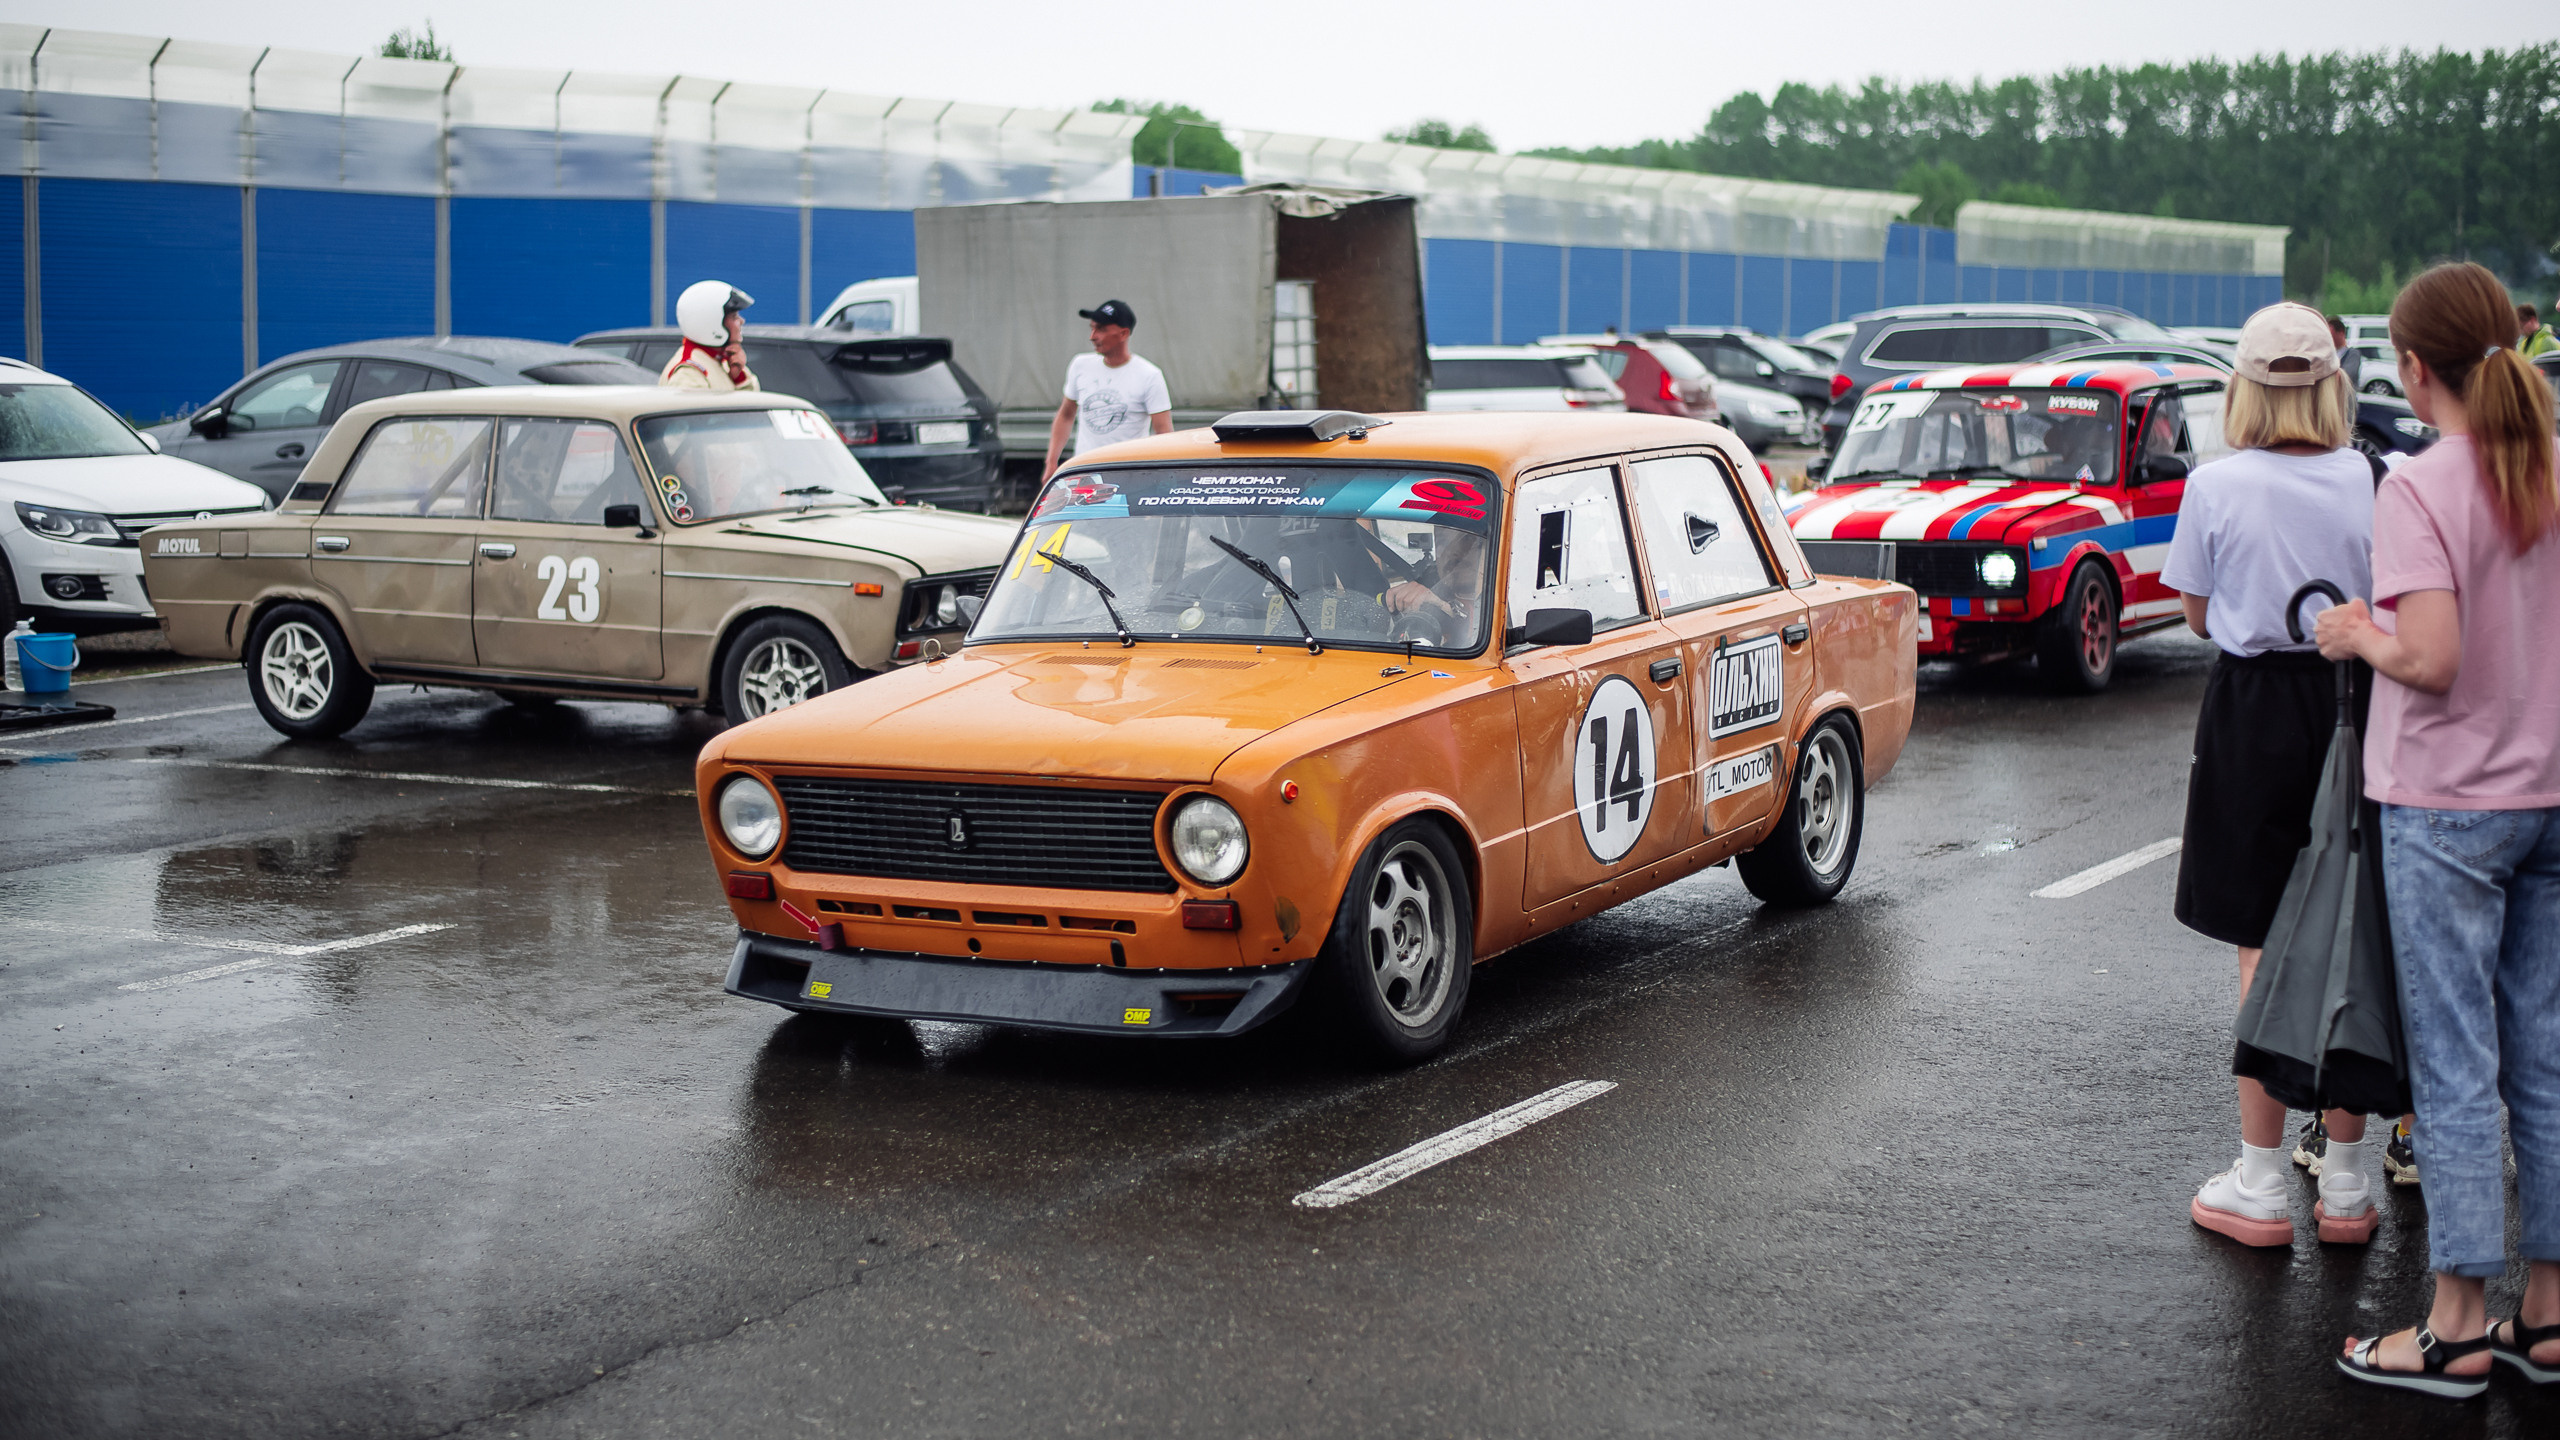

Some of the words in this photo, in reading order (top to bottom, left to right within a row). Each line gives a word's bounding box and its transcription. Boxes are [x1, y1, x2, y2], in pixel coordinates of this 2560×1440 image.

[2048, 394, 2100, 412] КУБОК
[1855, 403, 1895, 426] 27
[1192, 476, 1286, 485] ЧЕМПИОНАТ
[1169, 487, 1267, 495] КРАСНОЯРСКОГО
[1267, 487, 1300, 495] КРАЯ
[1138, 496, 1160, 506] ПО
[1160, 496, 1257, 506] КОЛЬЦЕВЫМ
[1258, 496, 1325, 506] ГОНКАМ
[158, 537, 201, 553] MOTUL
[1010, 523, 1072, 581] 14
[537, 554, 600, 623] 23
[1713, 645, 1778, 717] ОЛЬХИН
[1716, 703, 1774, 728] RACING
[1590, 707, 1644, 833] 14
[810, 983, 832, 996] OMP
[1124, 1009, 1151, 1022] OMP
